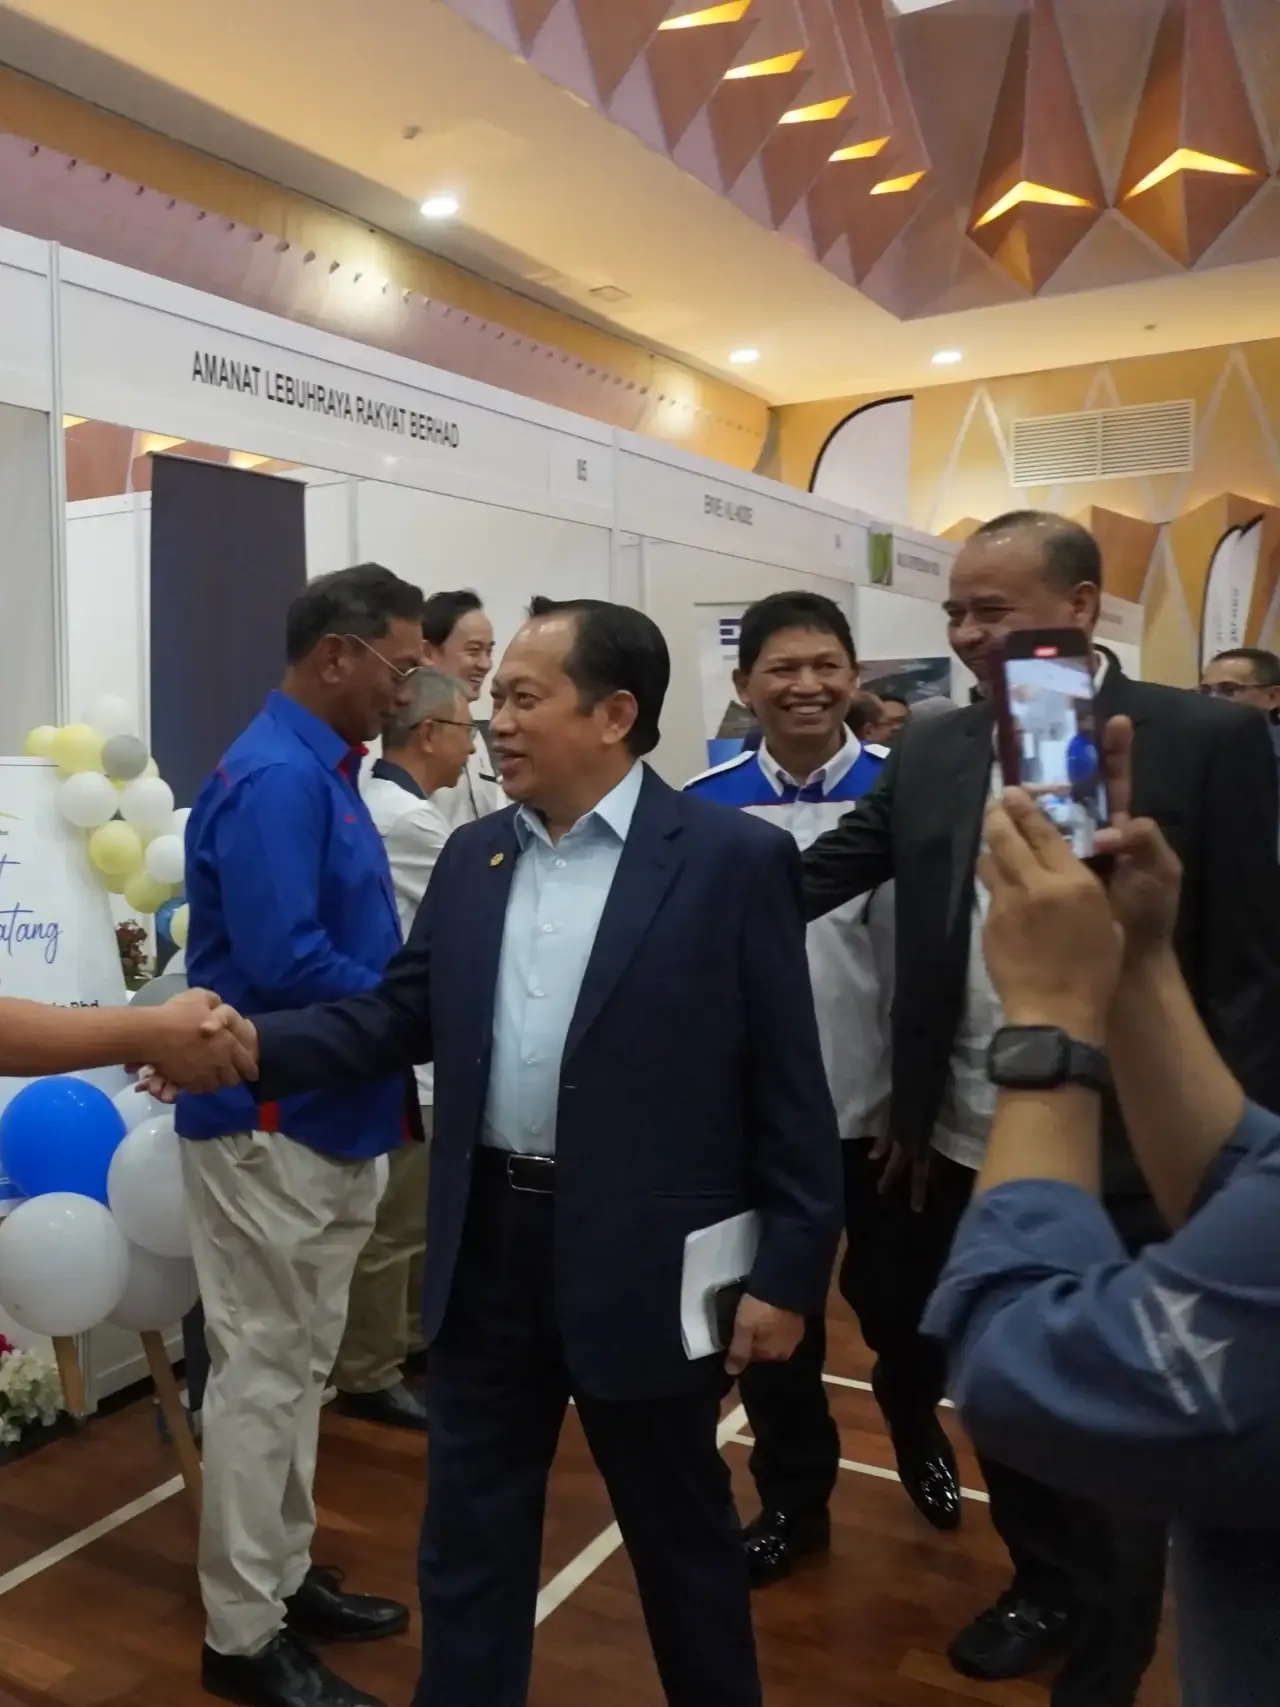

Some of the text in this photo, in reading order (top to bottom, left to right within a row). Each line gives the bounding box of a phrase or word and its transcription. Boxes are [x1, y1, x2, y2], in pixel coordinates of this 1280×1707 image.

[192, 350, 460, 448] AMANAT LEBUHRAYA RAKYAT BERHAD
